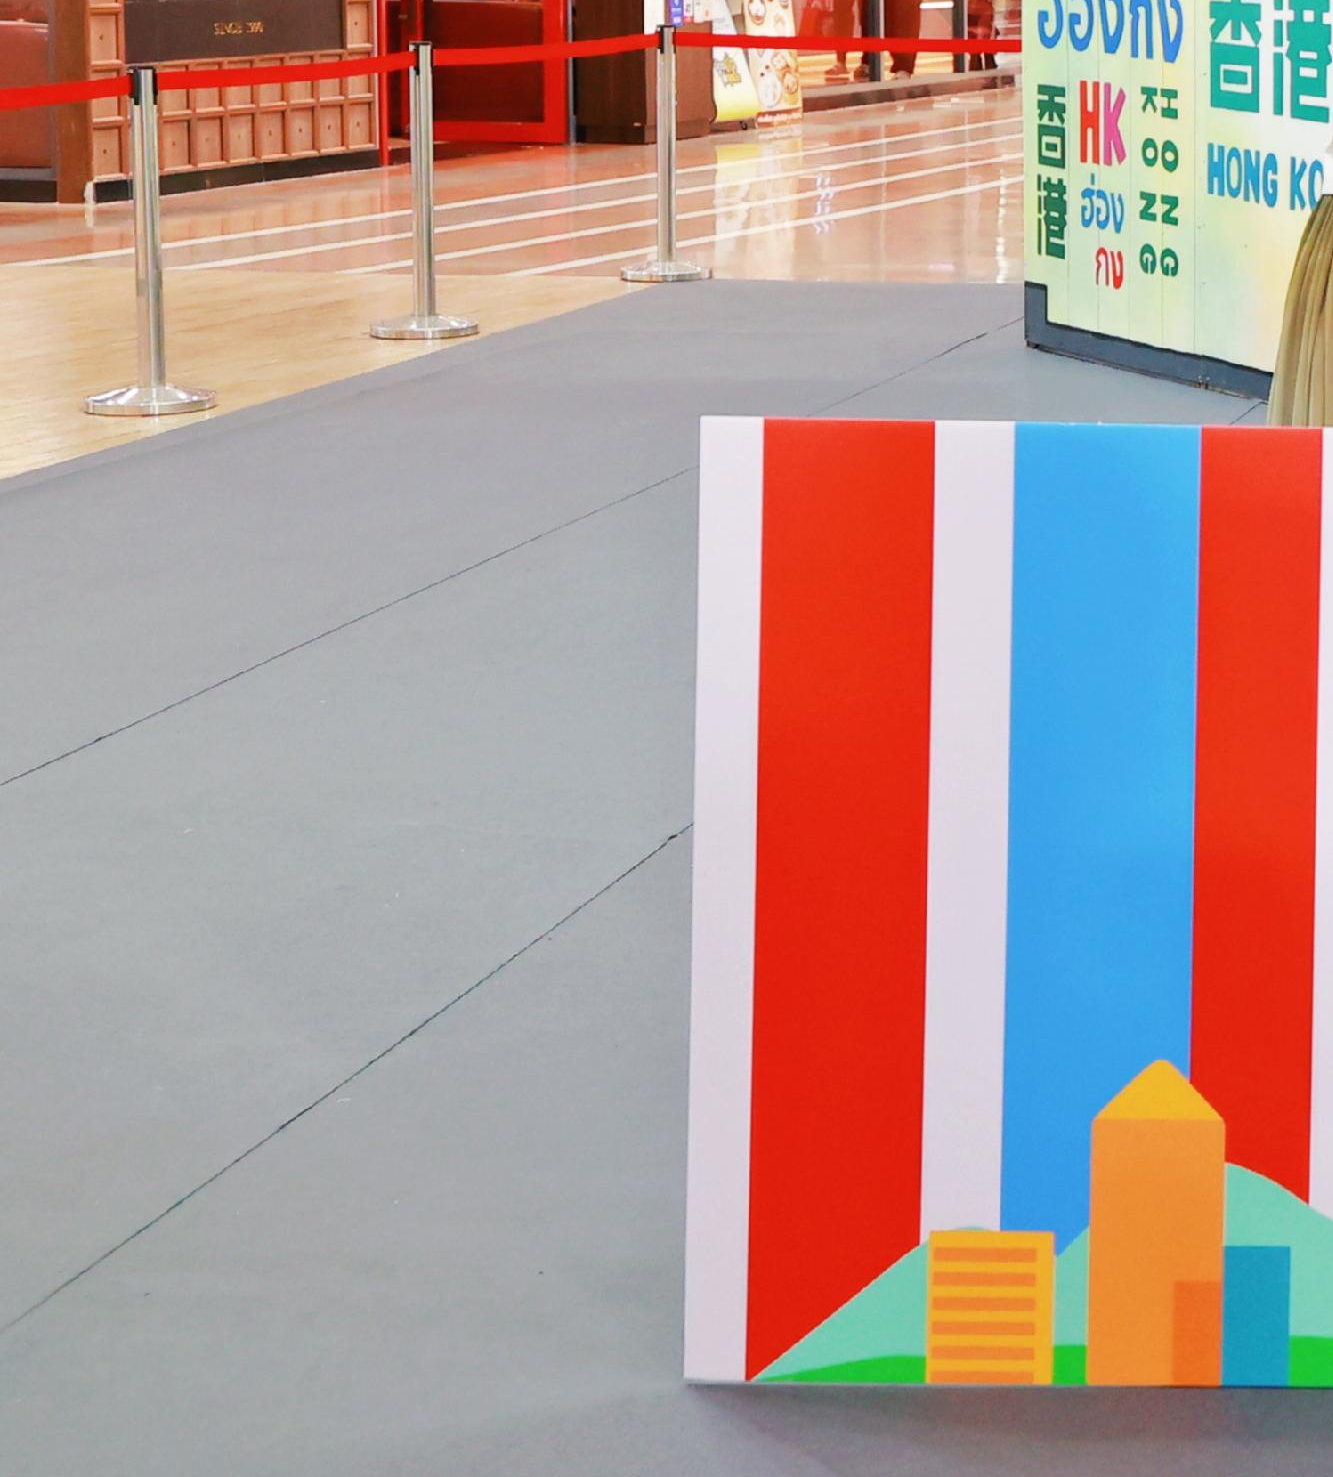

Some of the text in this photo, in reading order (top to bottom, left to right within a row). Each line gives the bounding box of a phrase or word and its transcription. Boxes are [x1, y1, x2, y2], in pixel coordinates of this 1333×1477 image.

[1079, 80, 1127, 166] HK
[1037, 84, 1067, 259] 香港
[1081, 173, 1124, 234] ฮ่อง
[1139, 86, 1158, 275] KONG
[1160, 88, 1179, 277] HONG
[1207, 143, 1324, 211] HONG KO
[1095, 247, 1124, 290] กง
